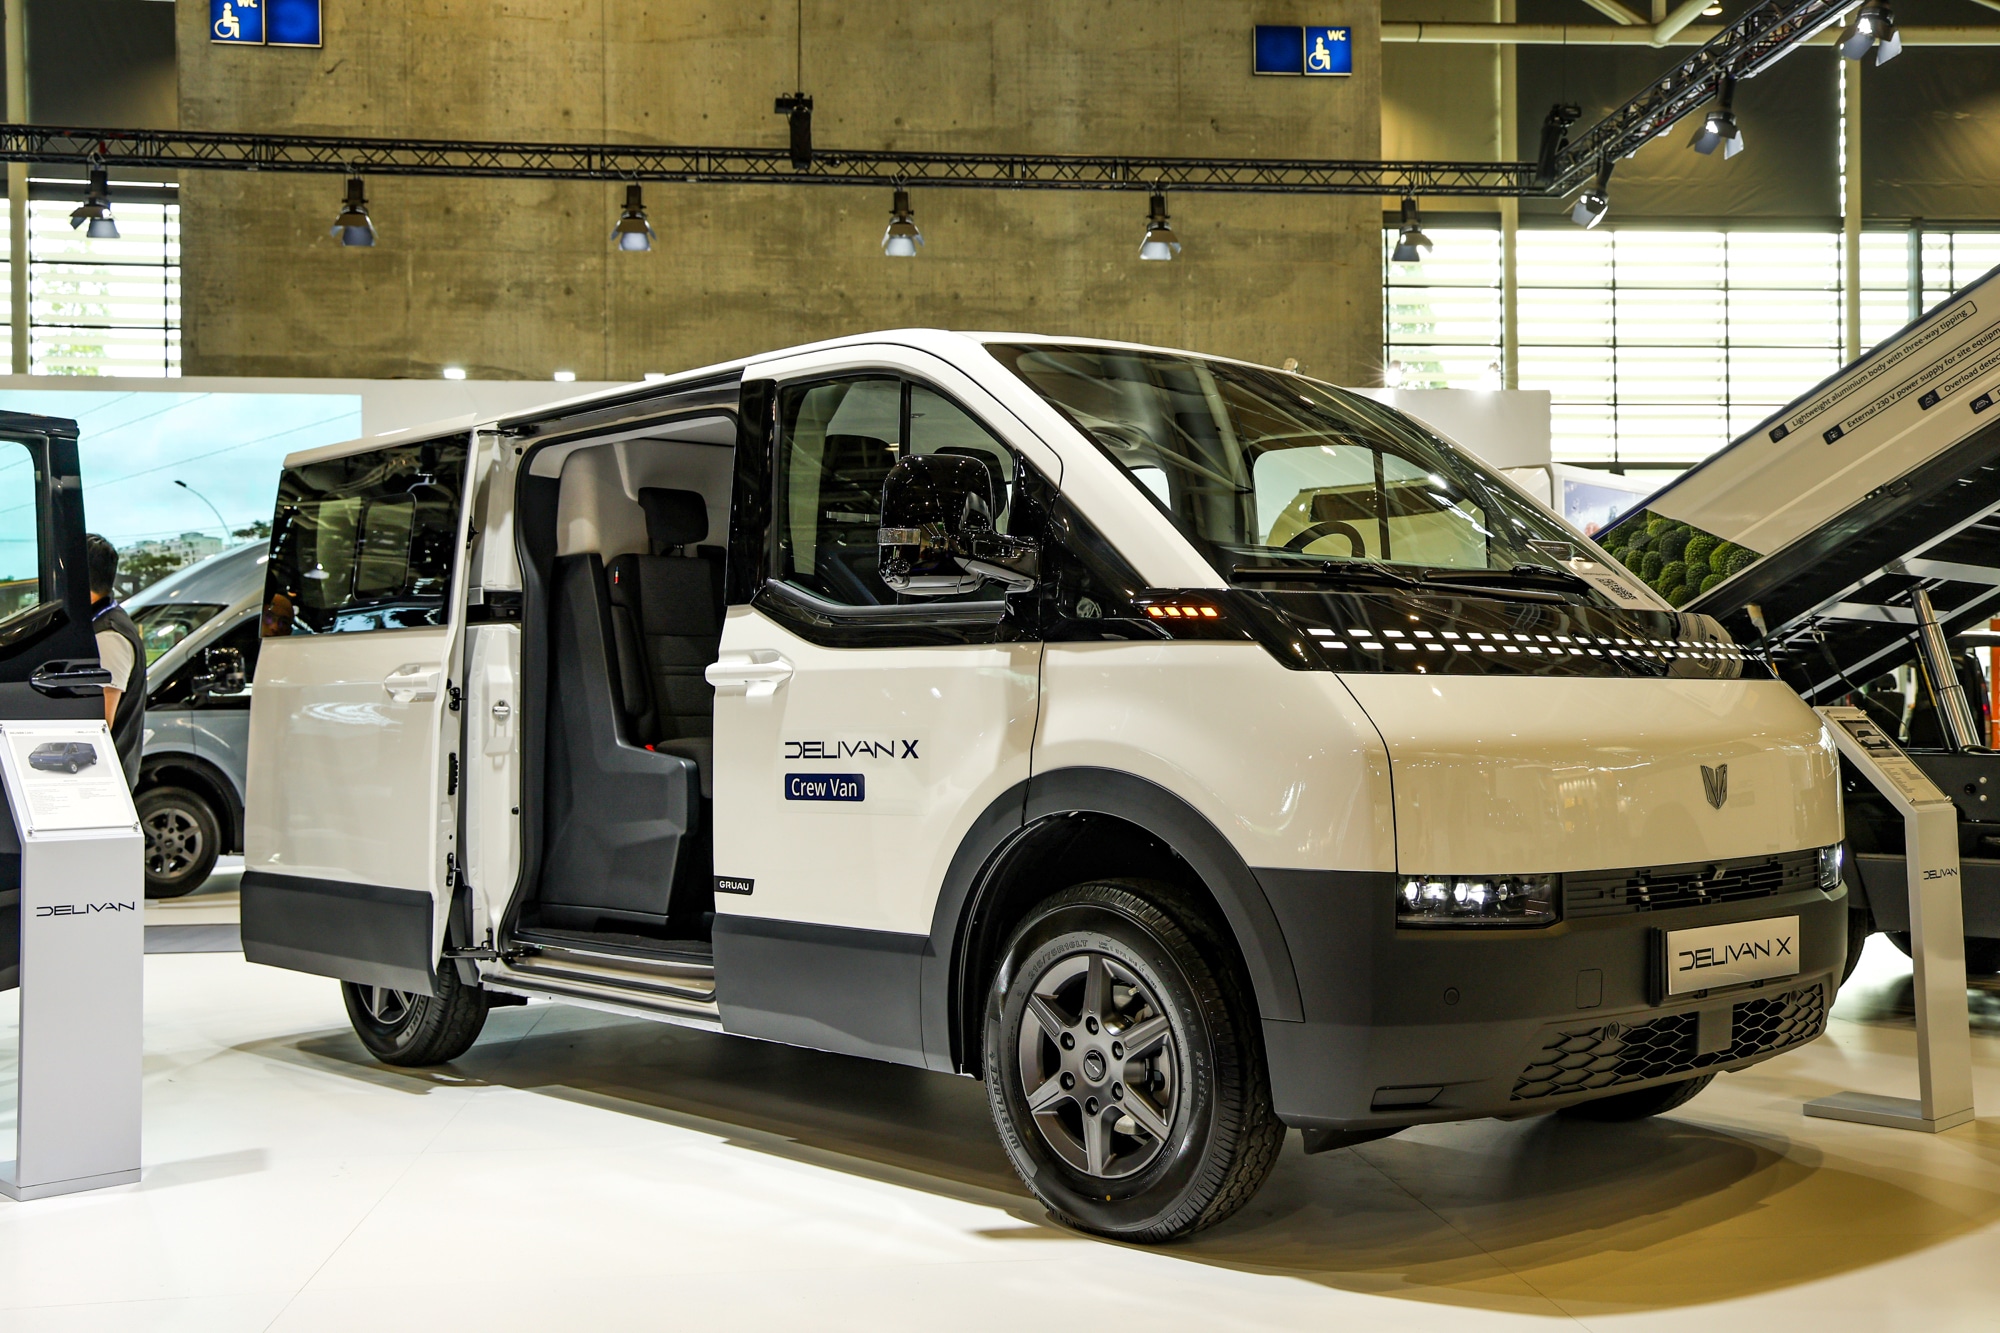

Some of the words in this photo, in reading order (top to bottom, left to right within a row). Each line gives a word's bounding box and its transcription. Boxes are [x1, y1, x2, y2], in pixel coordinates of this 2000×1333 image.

[236, 0, 258, 8] WC
[1327, 29, 1346, 41] WC
[1791, 398, 1831, 427] Lightweight
[1831, 375, 1868, 401] aluminium
[1867, 361, 1887, 377] body
[1886, 352, 1904, 365] with
[1903, 327, 1940, 354] three-way
[1940, 310, 1968, 330] tipping
[1846, 405, 1876, 428] External
[1876, 397, 1890, 410] 230
[1889, 393, 1896, 401] V
[1896, 379, 1919, 398] power
[1919, 363, 1944, 382] supply
[1944, 356, 1957, 366] for
[1956, 345, 1971, 358] site
[1943, 368, 1979, 392] Overload
[785, 740, 895, 759] DELIVAN
[901, 739, 919, 759] X
[791, 777, 827, 797] Crew
[829, 778, 858, 798] Van
[1923, 867, 1957, 880] DELIVAN
[719, 880, 749, 891] GRUAU
[36, 901, 135, 917] DELIVAN
[1679, 939, 1770, 972] DELIVAN
[1776, 936, 1791, 956] X
